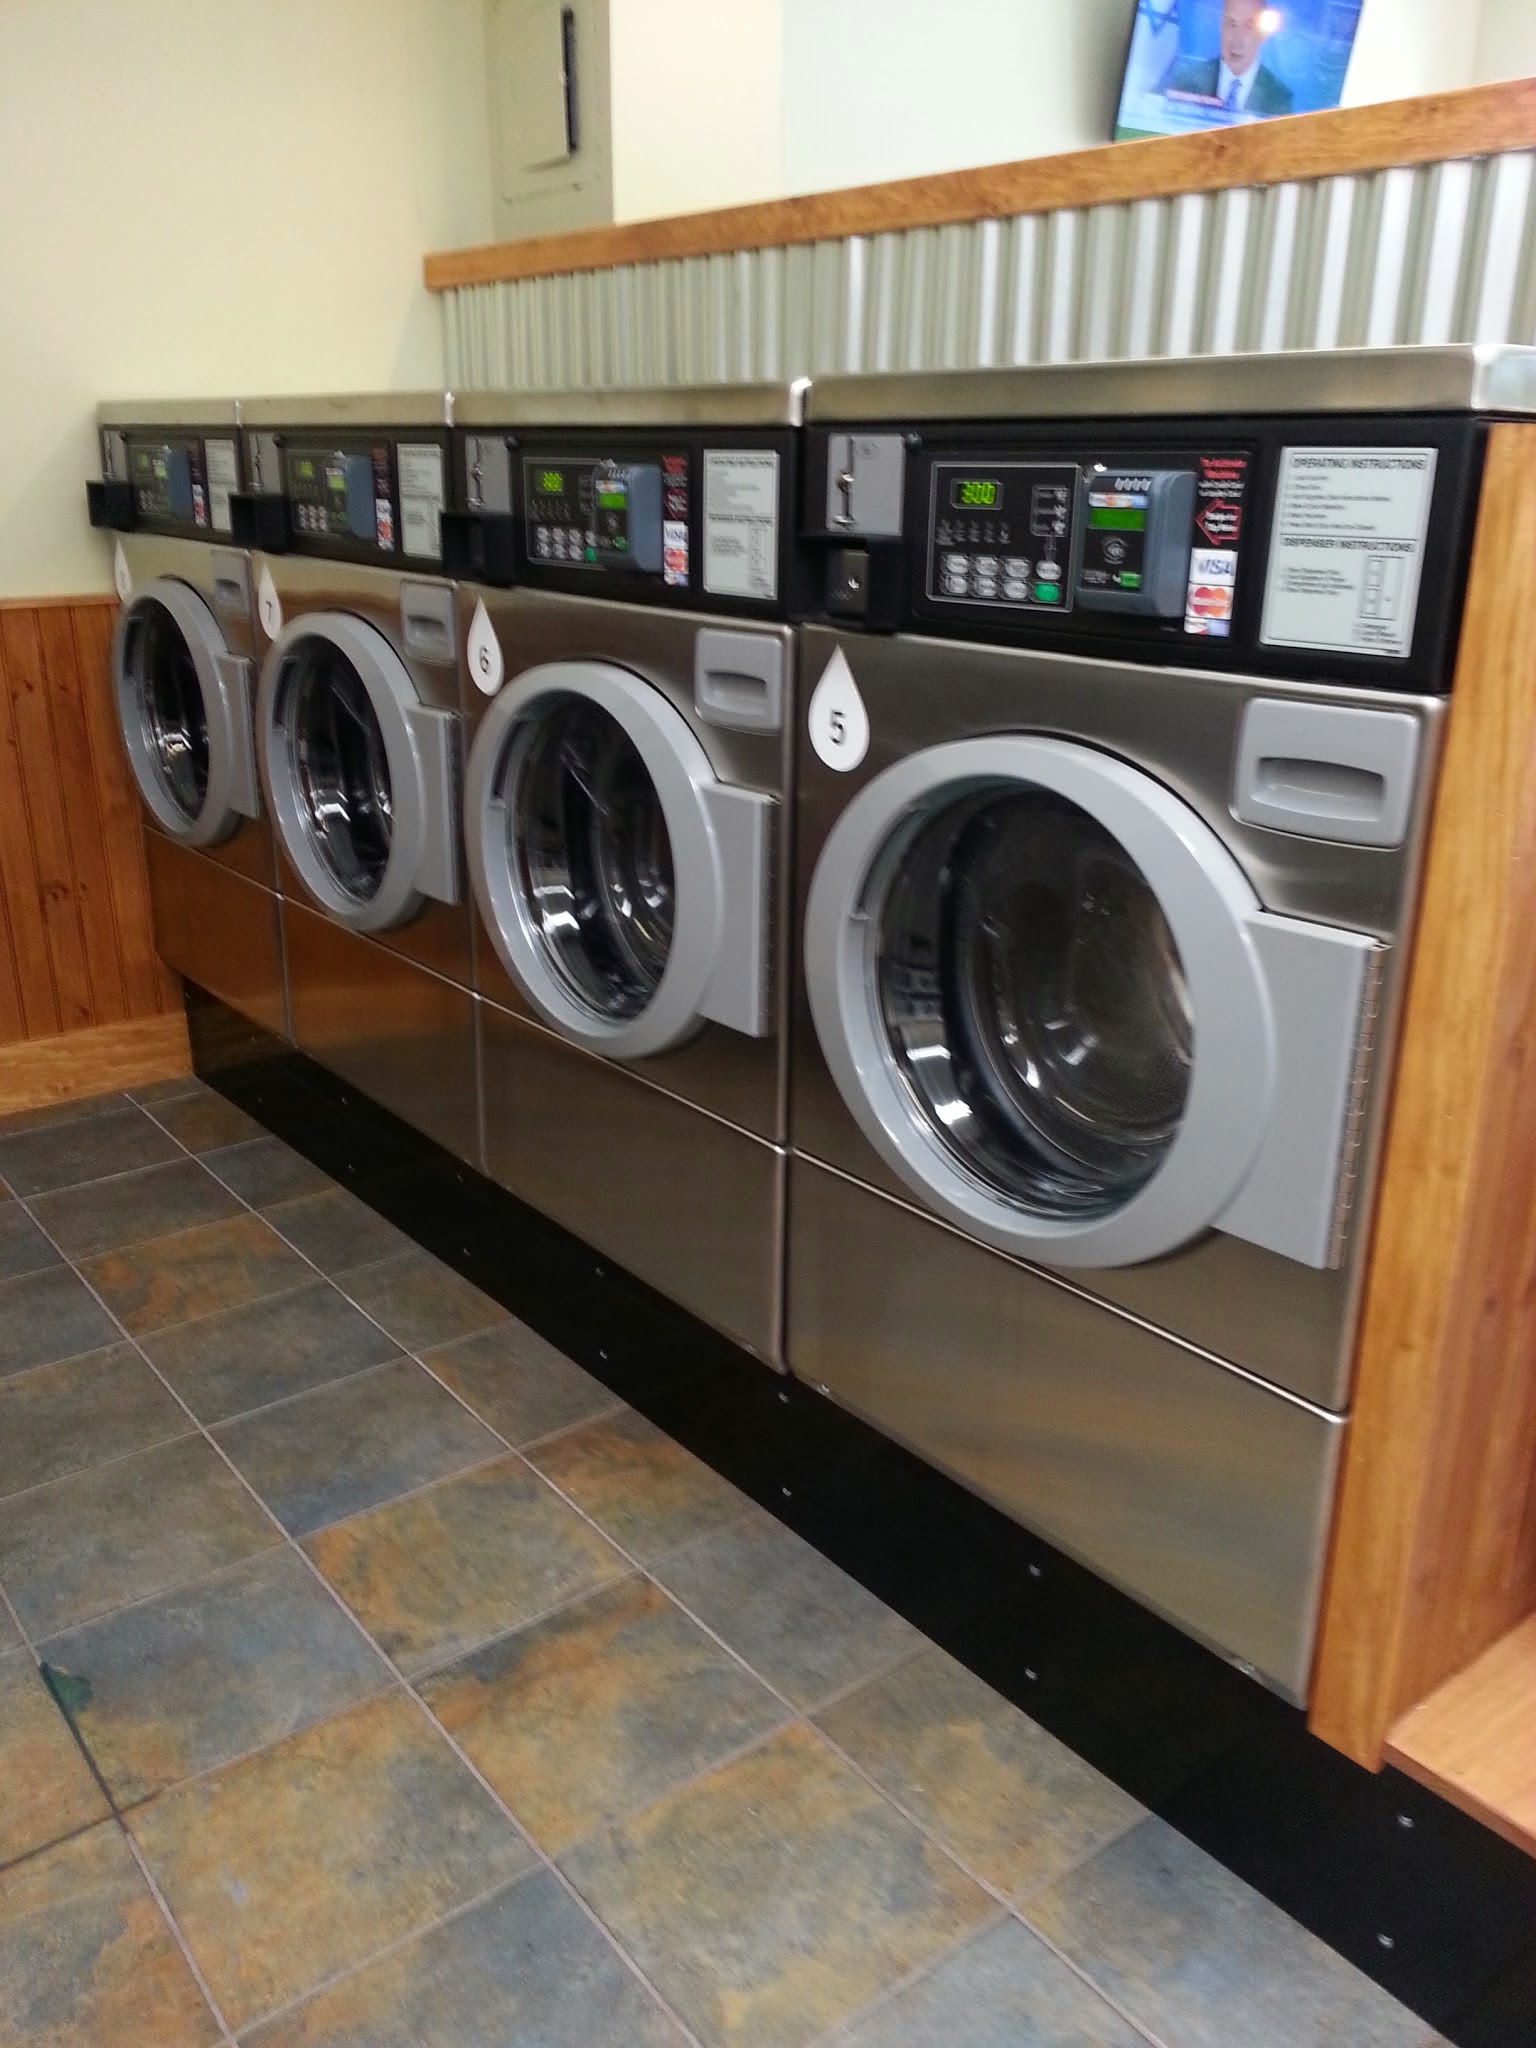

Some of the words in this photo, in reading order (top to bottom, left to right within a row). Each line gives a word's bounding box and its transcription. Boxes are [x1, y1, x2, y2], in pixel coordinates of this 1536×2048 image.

[1292, 458, 1347, 469] OPERATING
[1351, 457, 1427, 470] INSTRUCTIONS
[1340, 538, 1415, 552] INSTRUCTIONS
[1199, 558, 1236, 577] VISA
[264, 599, 273, 623] 7
[478, 644, 491, 676] 6
[830, 710, 846, 746] 5
